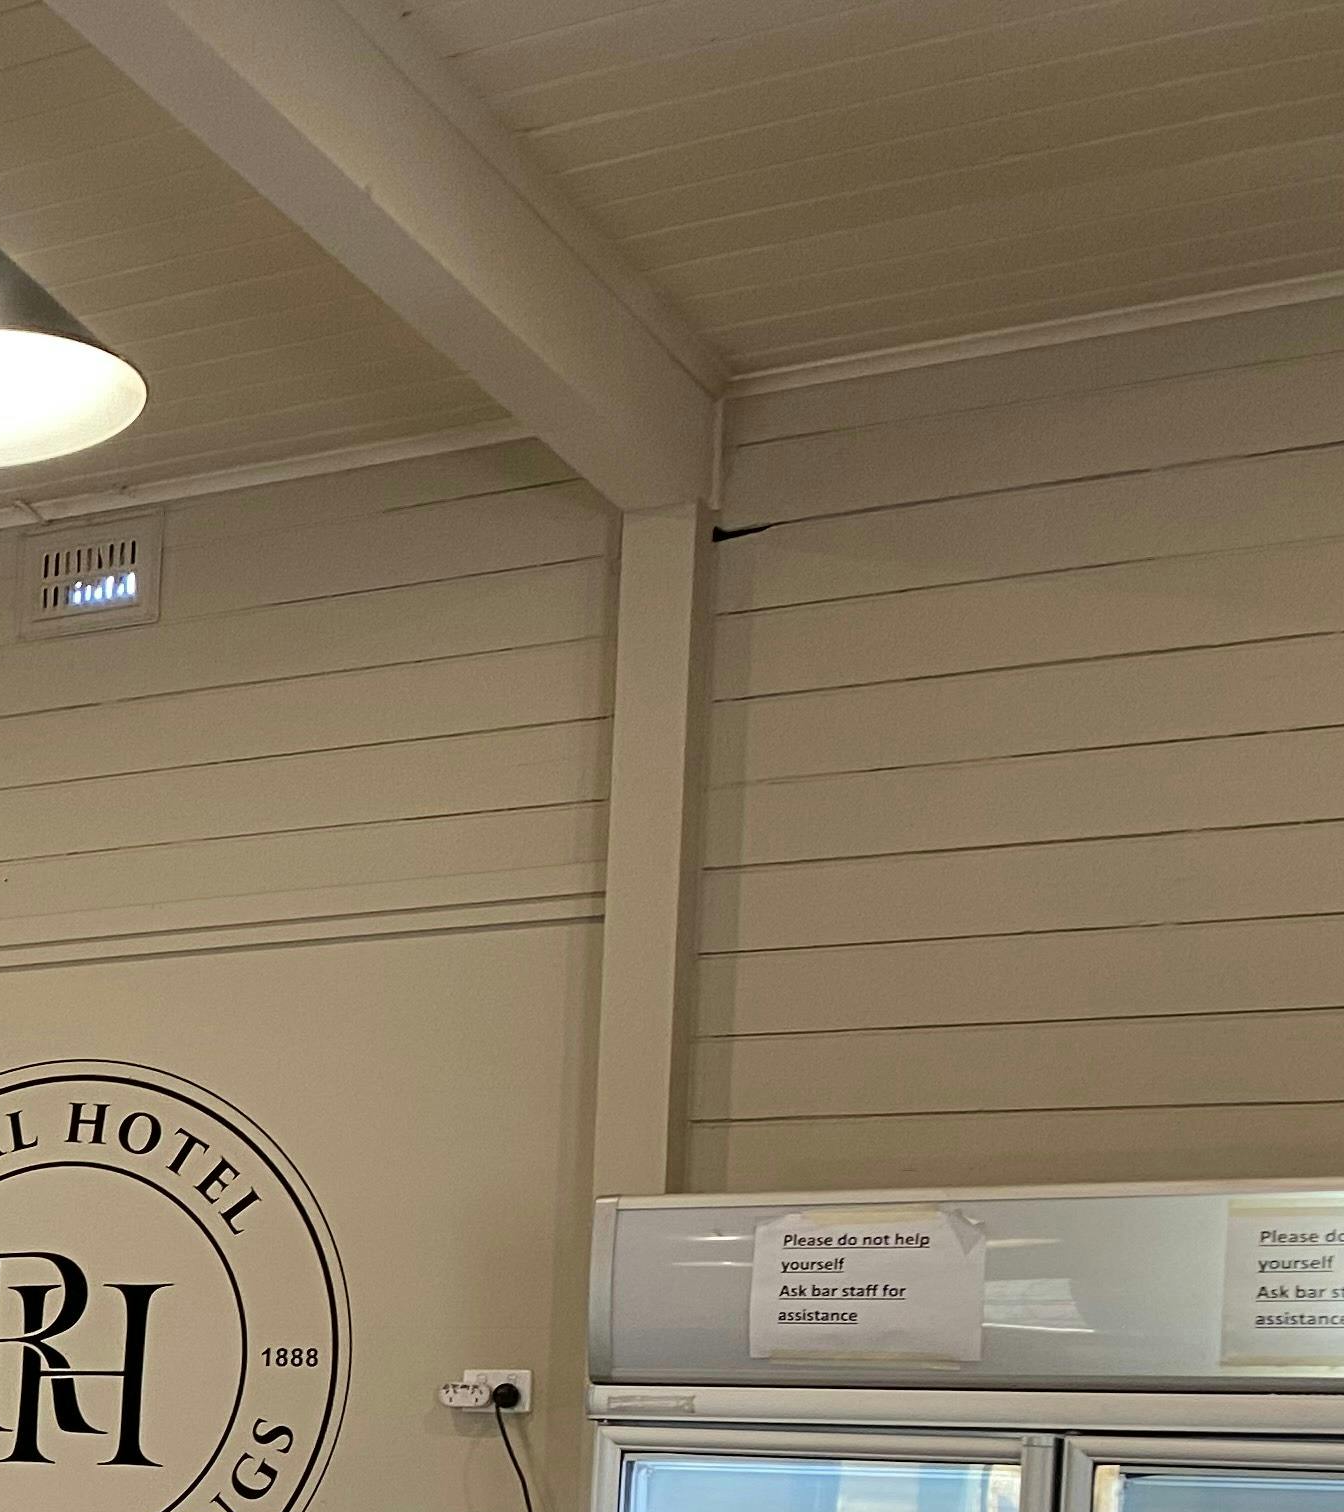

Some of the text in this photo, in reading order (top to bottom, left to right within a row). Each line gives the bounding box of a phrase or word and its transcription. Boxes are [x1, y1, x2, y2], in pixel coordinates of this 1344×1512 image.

[64, 1101, 263, 1236] HOTEL
[782, 1231, 931, 1250] Please do not help
[1260, 1230, 1319, 1243] Please
[781, 1256, 845, 1274] yourself
[1258, 1256, 1335, 1272] yourself
[779, 1283, 907, 1298] Ask bar staff for
[1257, 1286, 1289, 1298] Ask
[1296, 1286, 1326, 1298] bar
[778, 1307, 859, 1323] assistance
[260, 1347, 319, 1367] 1888
